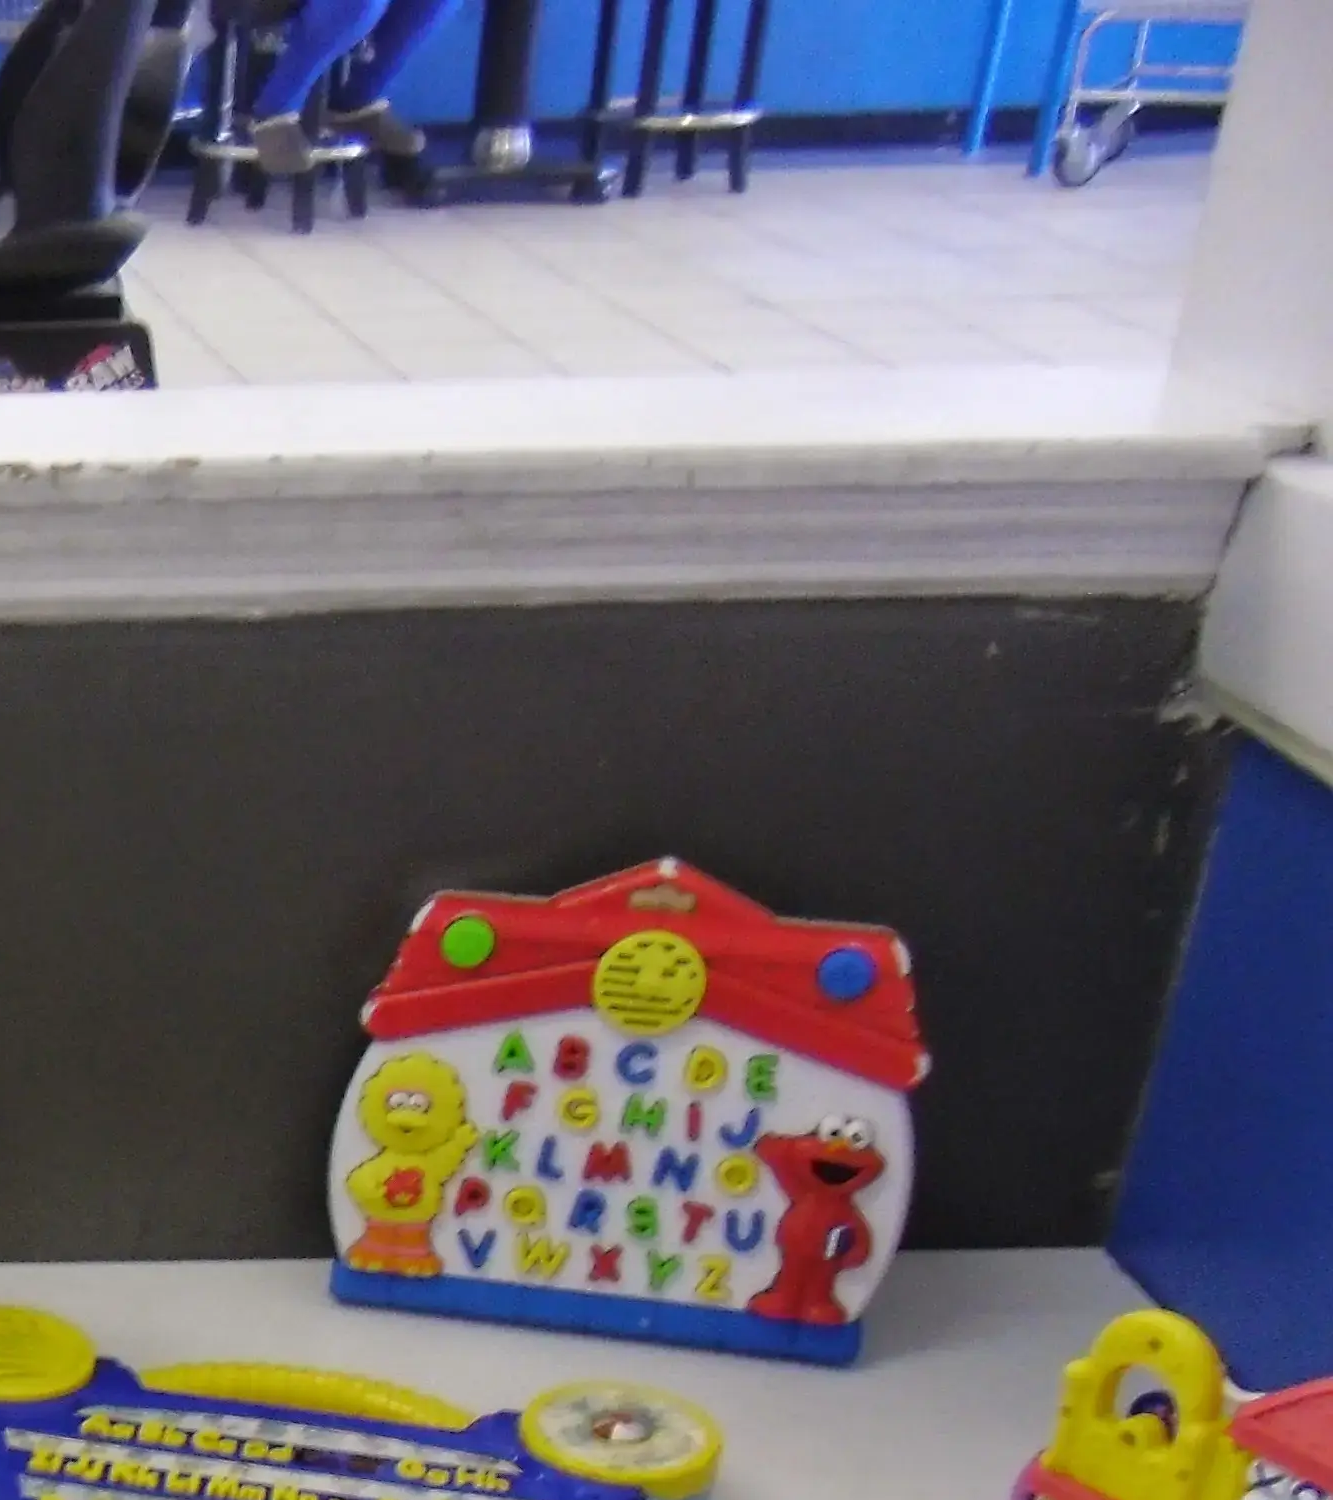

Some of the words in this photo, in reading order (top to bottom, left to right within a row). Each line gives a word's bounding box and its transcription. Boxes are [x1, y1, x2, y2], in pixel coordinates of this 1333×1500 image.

[493, 1028, 535, 1075] A
[553, 1035, 591, 1080] B
[616, 1042, 658, 1085] C
[684, 1045, 728, 1094] D
[745, 1053, 779, 1101] E
[501, 1080, 538, 1122] F
[559, 1086, 600, 1131] G
[619, 1093, 667, 1136] H
[687, 1100, 702, 1142] I
[719, 1107, 760, 1148] J
[483, 1130, 520, 1172] K
[536, 1136, 564, 1181] L
[583, 1141, 631, 1182] M
[652, 1146, 700, 1192] N
[715, 1155, 758, 1197] O
[455, 1176, 492, 1217] P
[567, 1188, 606, 1234] R
[627, 1195, 659, 1240] S
[681, 1200, 715, 1244] T
[725, 1209, 766, 1252] U
[457, 1228, 497, 1269] V
[516, 1233, 572, 1279] W
[588, 1243, 623, 1283] X
[647, 1250, 681, 1292] Y
[695, 1253, 731, 1300] Z
